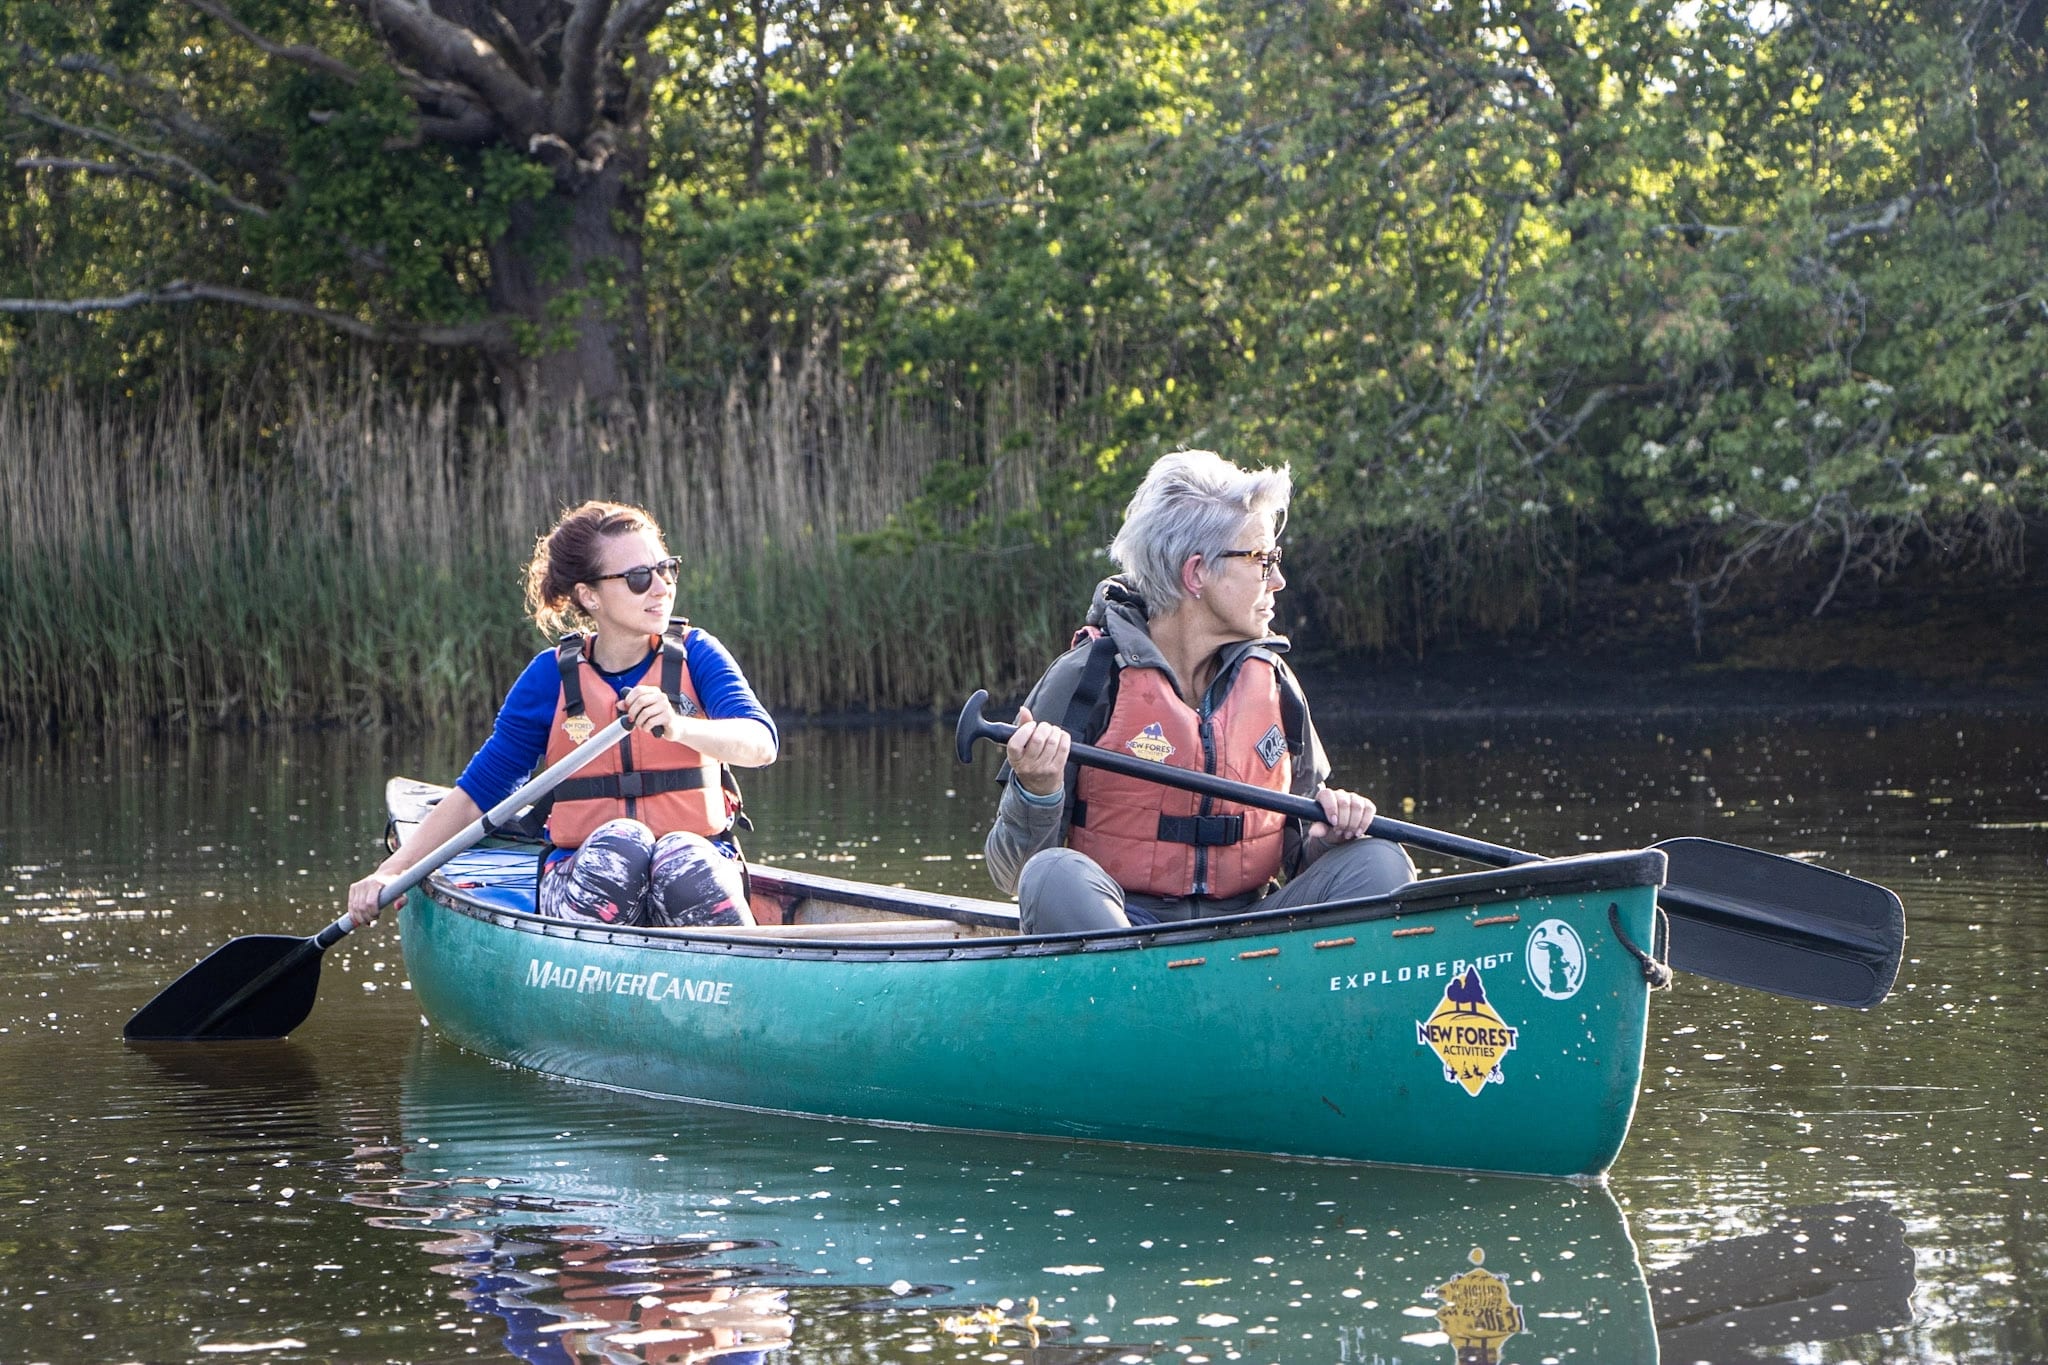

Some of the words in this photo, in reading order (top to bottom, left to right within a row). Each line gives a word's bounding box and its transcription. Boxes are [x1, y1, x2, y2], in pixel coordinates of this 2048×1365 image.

[1145, 744, 1174, 754] FOREST
[1330, 959, 1466, 991] EXPLORER
[1418, 1025, 1452, 1043] NEW
[1456, 1027, 1516, 1047] FOREST
[1443, 1045, 1495, 1057] ACTIVITIES
